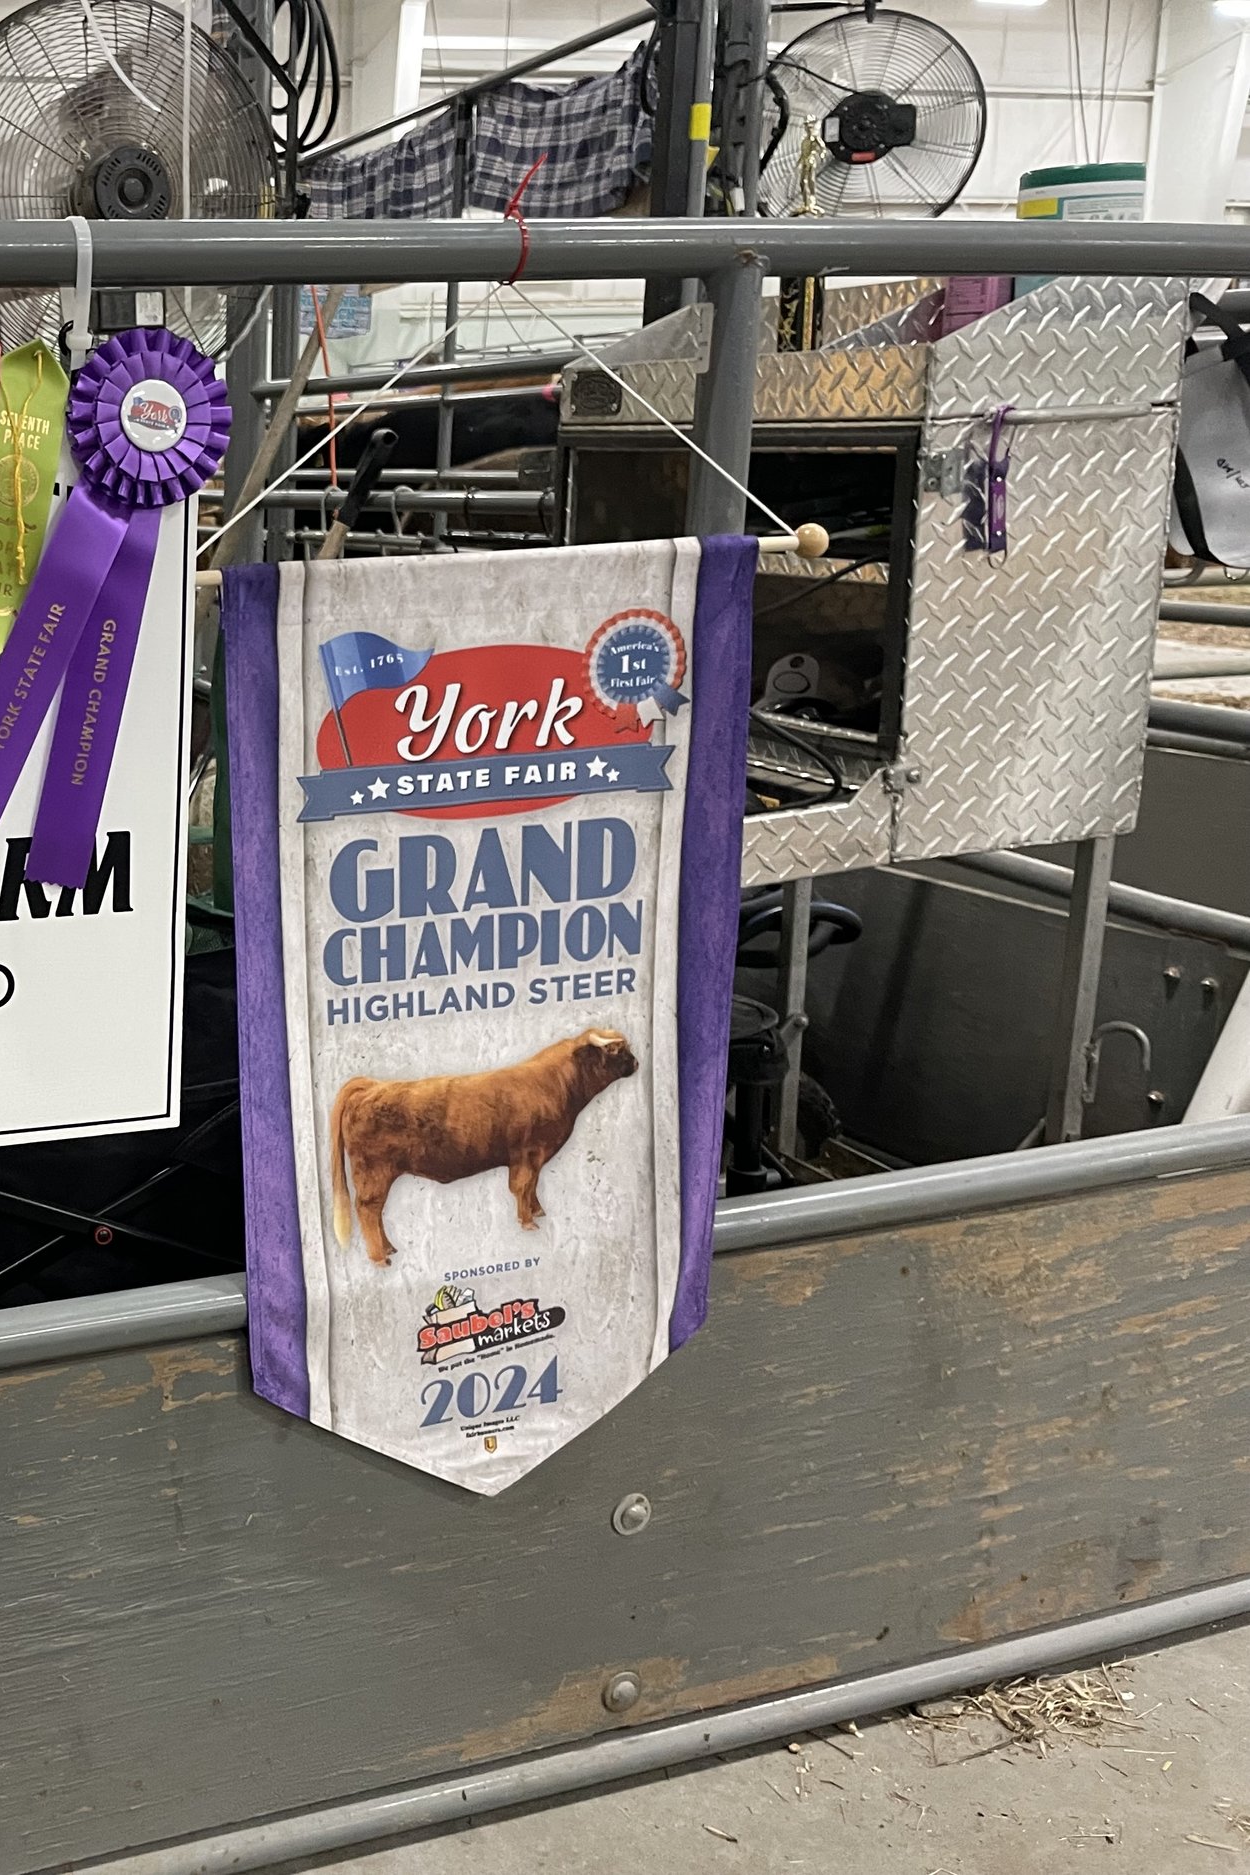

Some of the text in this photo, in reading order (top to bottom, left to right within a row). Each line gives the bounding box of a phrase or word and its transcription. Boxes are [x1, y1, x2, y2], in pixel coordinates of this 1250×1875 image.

[3, 428, 41, 450] PACE
[14, 645, 47, 700] STATE
[38, 603, 67, 644] FAIR
[370, 653, 404, 668] 1765
[610, 641, 660, 655] America's
[621, 654, 646, 674] 1st
[70, 619, 117, 786] GRAND CHAMPION
[610, 675, 656, 688] First Fair
[394, 678, 583, 763] York
[397, 761, 577, 797] STATE FAIR
[329, 817, 636, 923] GRAND
[323, 900, 643, 987] CHAMPION
[327, 967, 637, 1026] HIGHLAND STEER
[444, 1256, 541, 1282] SPONSORED BY
[419, 1300, 536, 1350] Saubel's
[478, 1311, 551, 1346] markets
[419, 1354, 564, 1428] 2024
